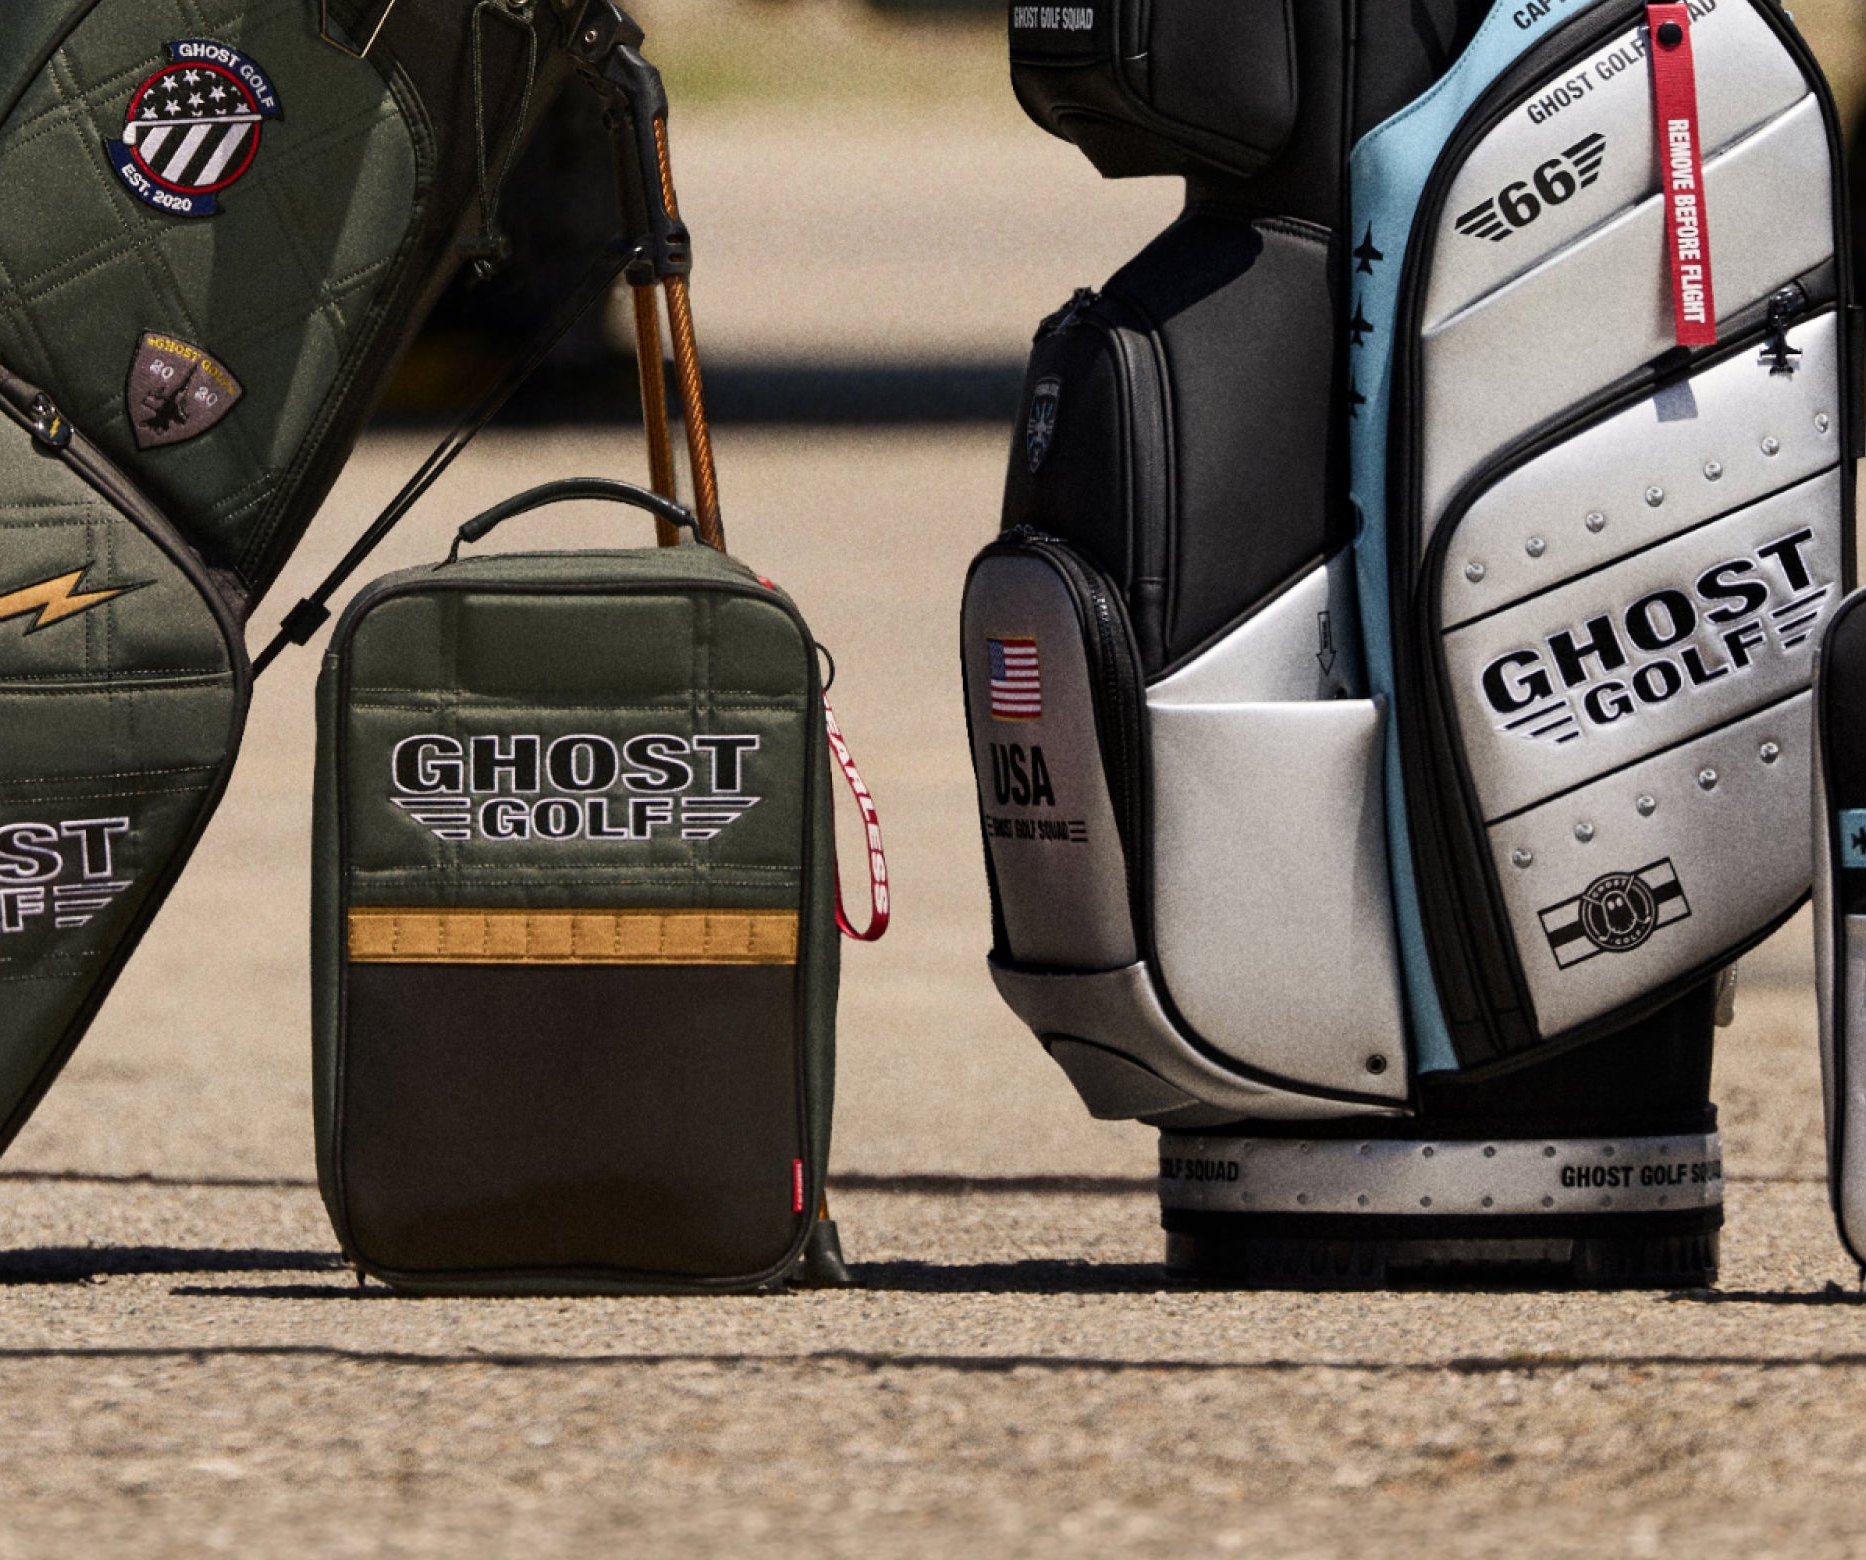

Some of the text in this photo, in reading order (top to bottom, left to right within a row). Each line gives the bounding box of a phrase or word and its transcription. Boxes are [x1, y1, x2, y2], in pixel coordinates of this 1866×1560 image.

[1013, 6, 1094, 31] GHOST GOLF SQUAD
[179, 43, 275, 108] GHOST GOLF
[1527, 38, 1647, 125] GHOST GOLF
[121, 163, 192, 211] EST. 2020
[1498, 158, 1576, 227] 66
[1668, 119, 1706, 323] REMOVE BEFORE FLIGHT
[1481, 527, 1814, 714] GHOST
[1583, 619, 1767, 726] GOLF
[392, 734, 761, 794] GHOST
[990, 743, 1055, 807] USA
[478, 797, 674, 840] GOLF
[1185, 1158, 1238, 1181] SQUAD
[1561, 1165, 1633, 1187] GHOST
[1640, 1163, 1687, 1186] GOLF
